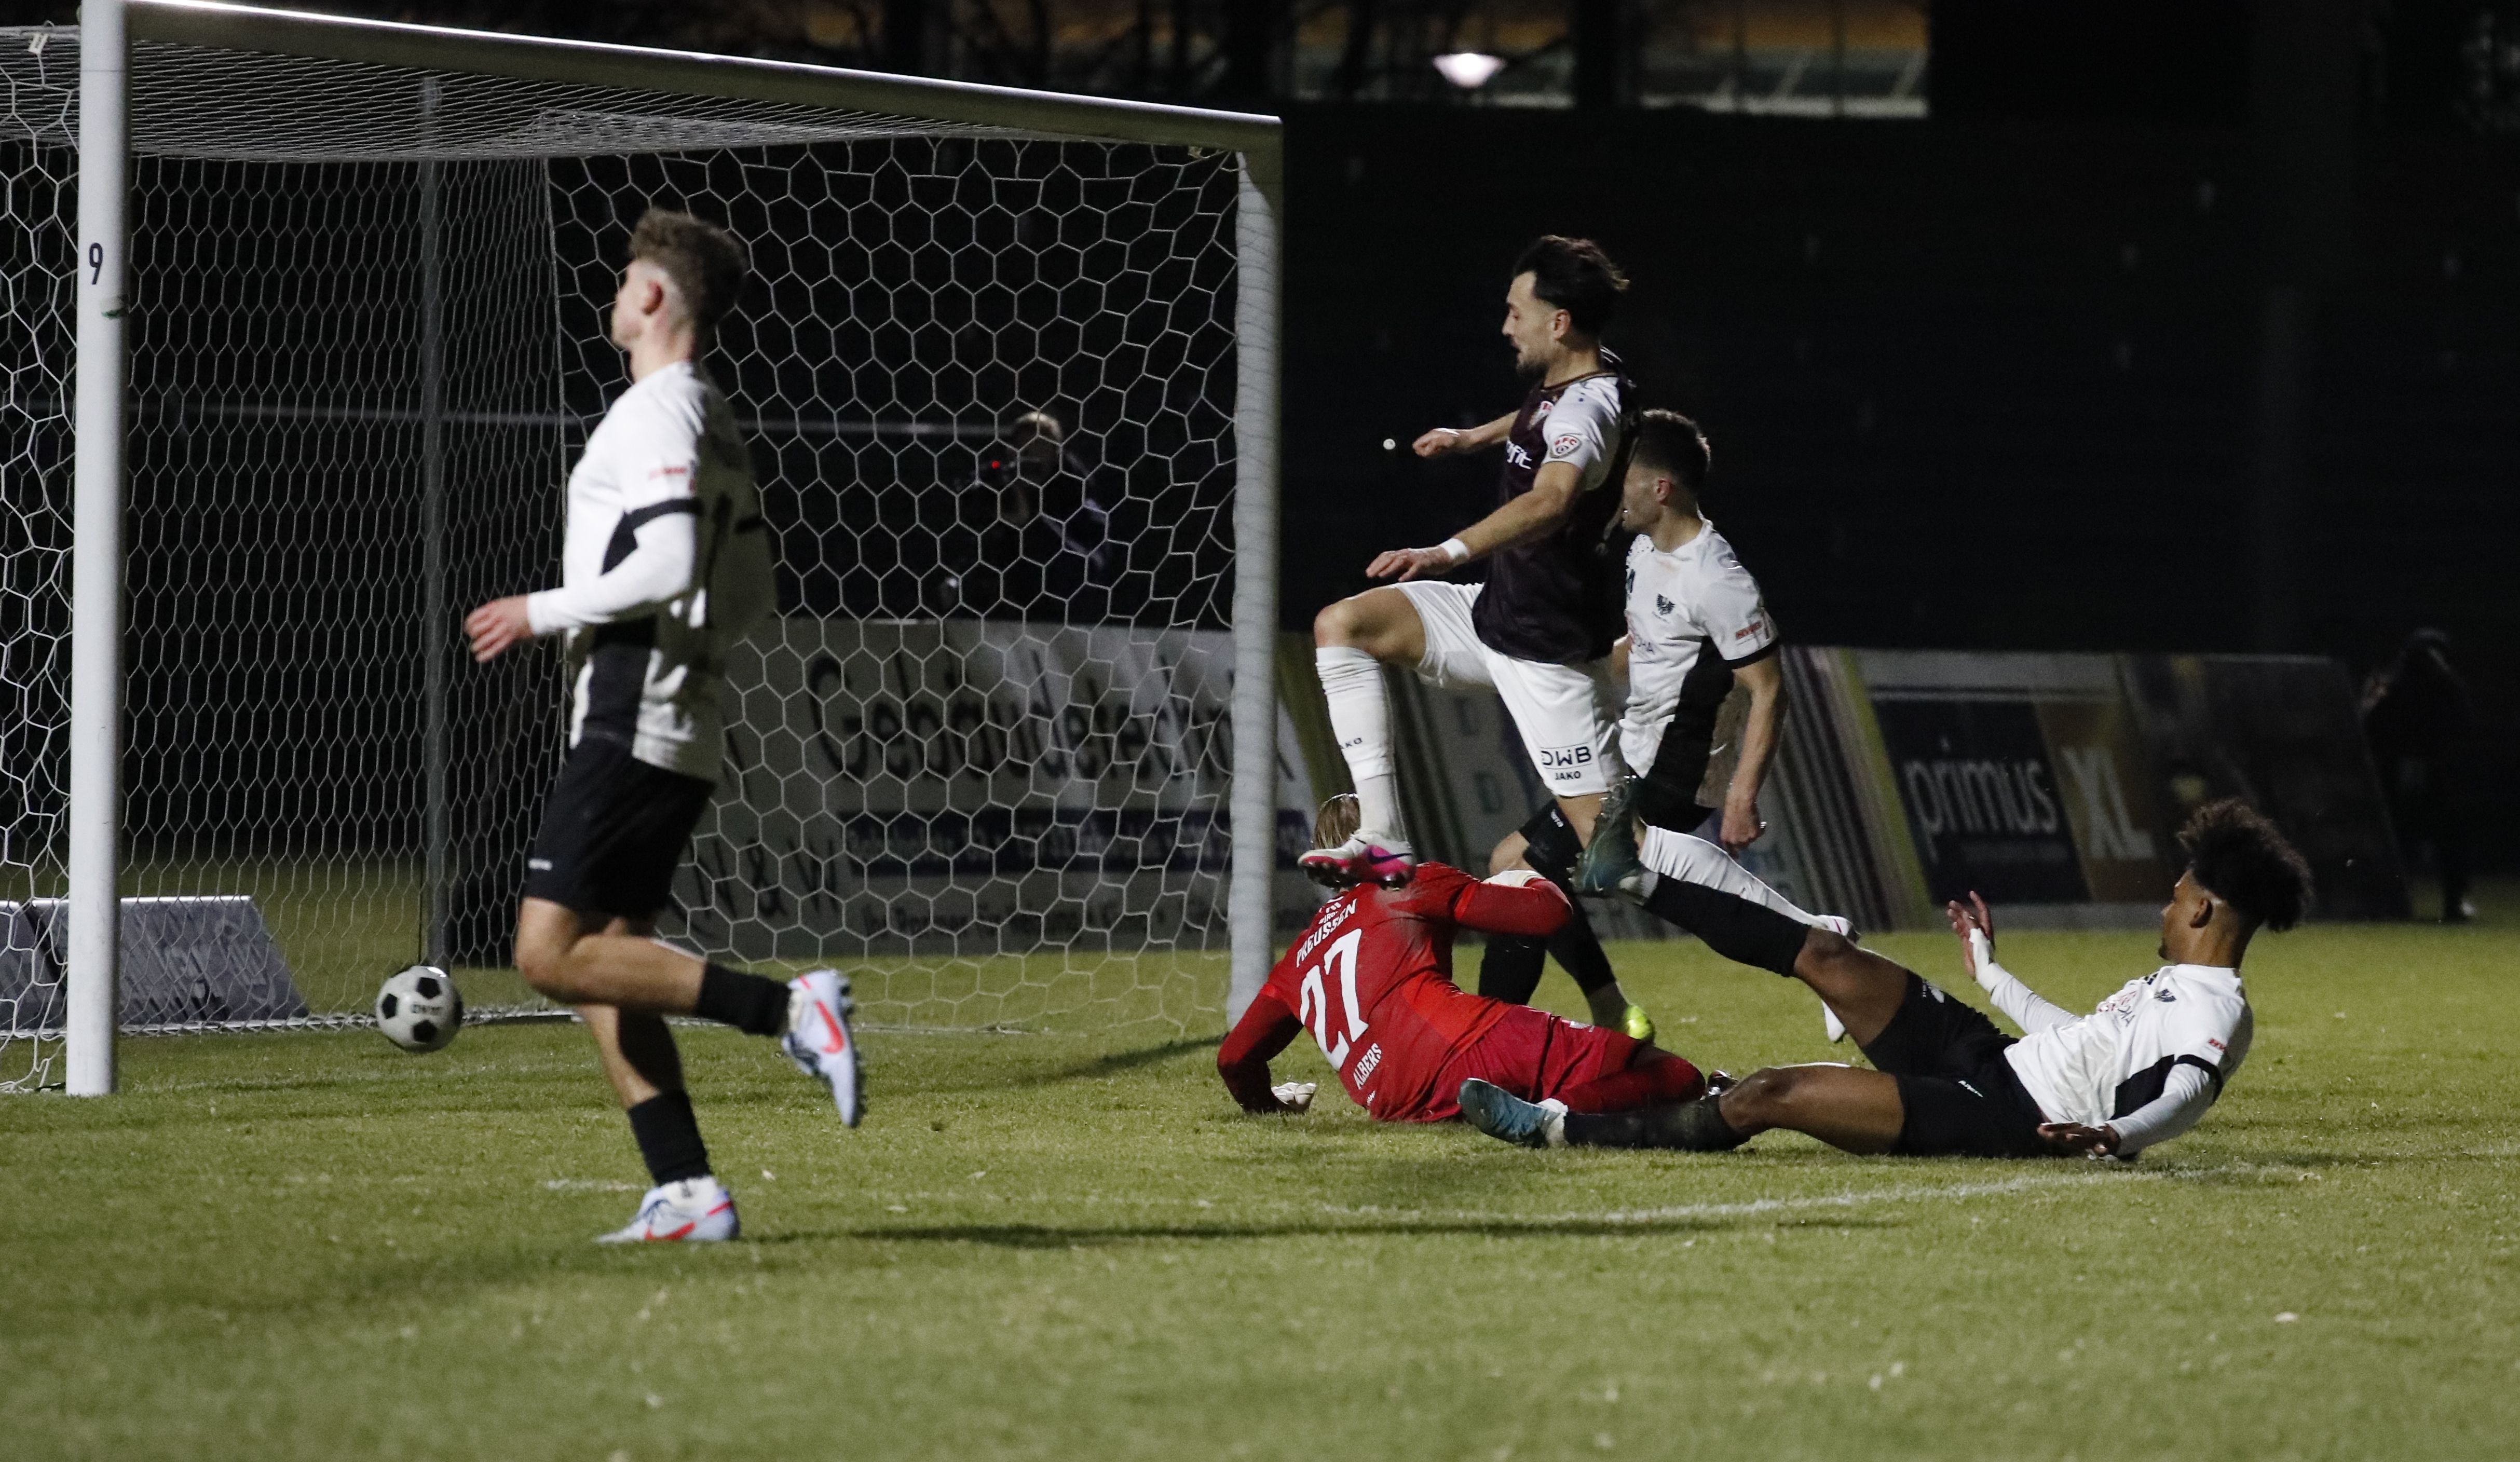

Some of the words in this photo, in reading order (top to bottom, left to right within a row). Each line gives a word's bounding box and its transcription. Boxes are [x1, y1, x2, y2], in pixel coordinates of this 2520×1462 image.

[89, 242, 103, 285] 9
[1555, 771, 1581, 781] JAKO
[1903, 734, 2059, 865] primus
[2061, 745, 2156, 859] XL
[1296, 898, 1358, 968] PREUSSEN
[1299, 927, 1369, 1072] 27
[1352, 1042, 1382, 1090] ALBERS
